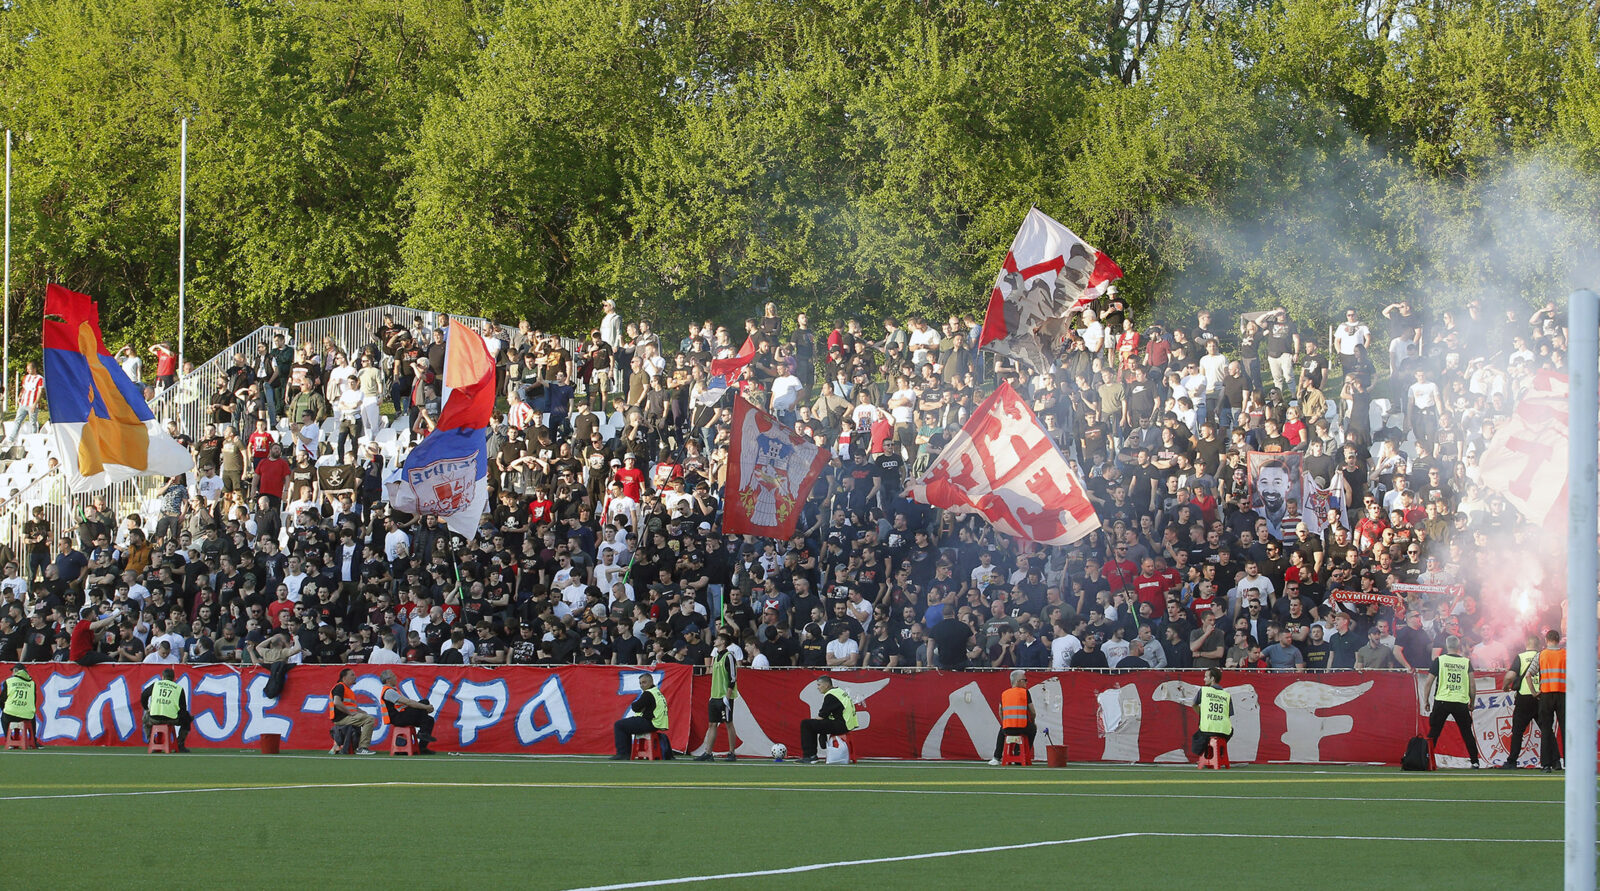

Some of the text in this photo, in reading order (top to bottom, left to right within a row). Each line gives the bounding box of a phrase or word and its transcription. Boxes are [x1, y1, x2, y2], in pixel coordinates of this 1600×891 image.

[1447, 673, 1462, 683] 295
[14, 689, 28, 699] 791
[159, 688, 173, 698] 157
[1209, 702, 1223, 713] 395
[1483, 730, 1495, 741] 19
